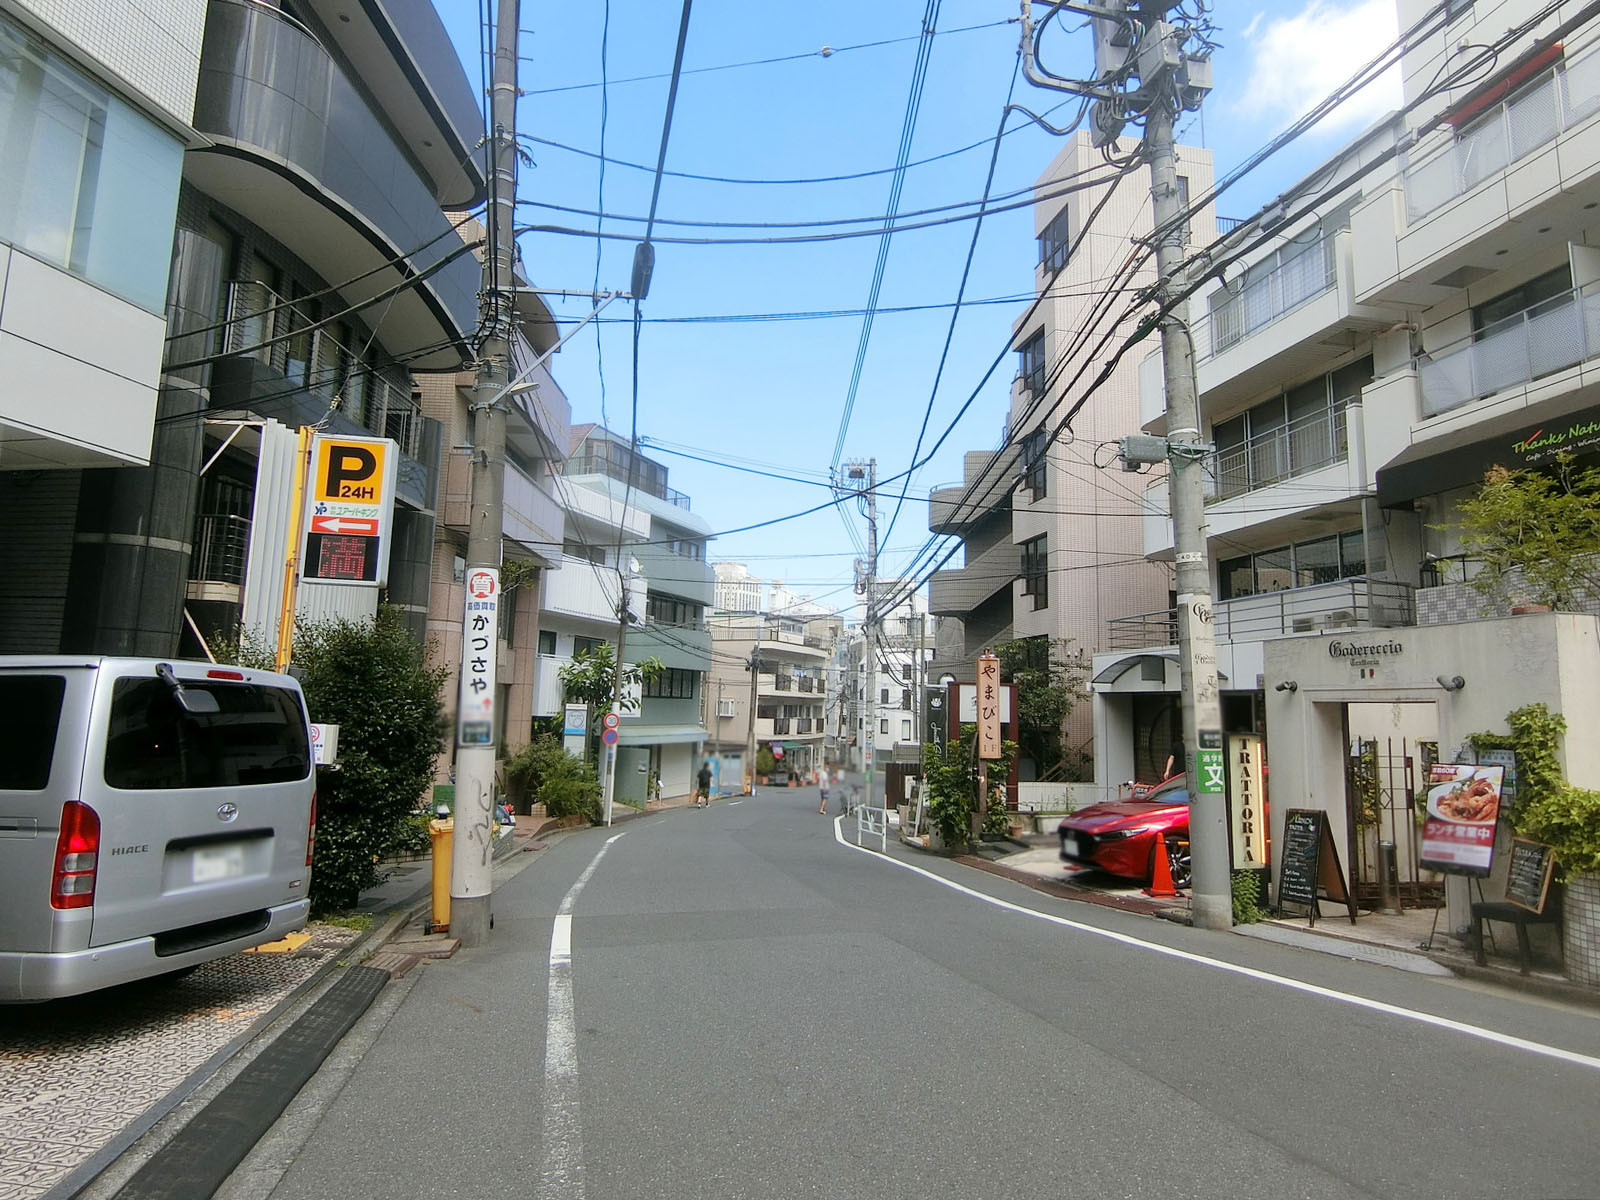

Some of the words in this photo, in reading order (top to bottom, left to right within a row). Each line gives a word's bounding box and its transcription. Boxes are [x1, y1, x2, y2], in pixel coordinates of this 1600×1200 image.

[1511, 431, 1567, 454] Thanks
[325, 445, 377, 498] P
[340, 485, 374, 500] 24H
[317, 537, 366, 580] 満
[467, 601, 496, 611] 高価買取
[469, 614, 490, 695] かづさや
[981, 664, 997, 741] やまびこ
[1203, 763, 1224, 786] 文
[1238, 737, 1254, 862] TRATTORIA
[111, 844, 150, 856] HIACE
